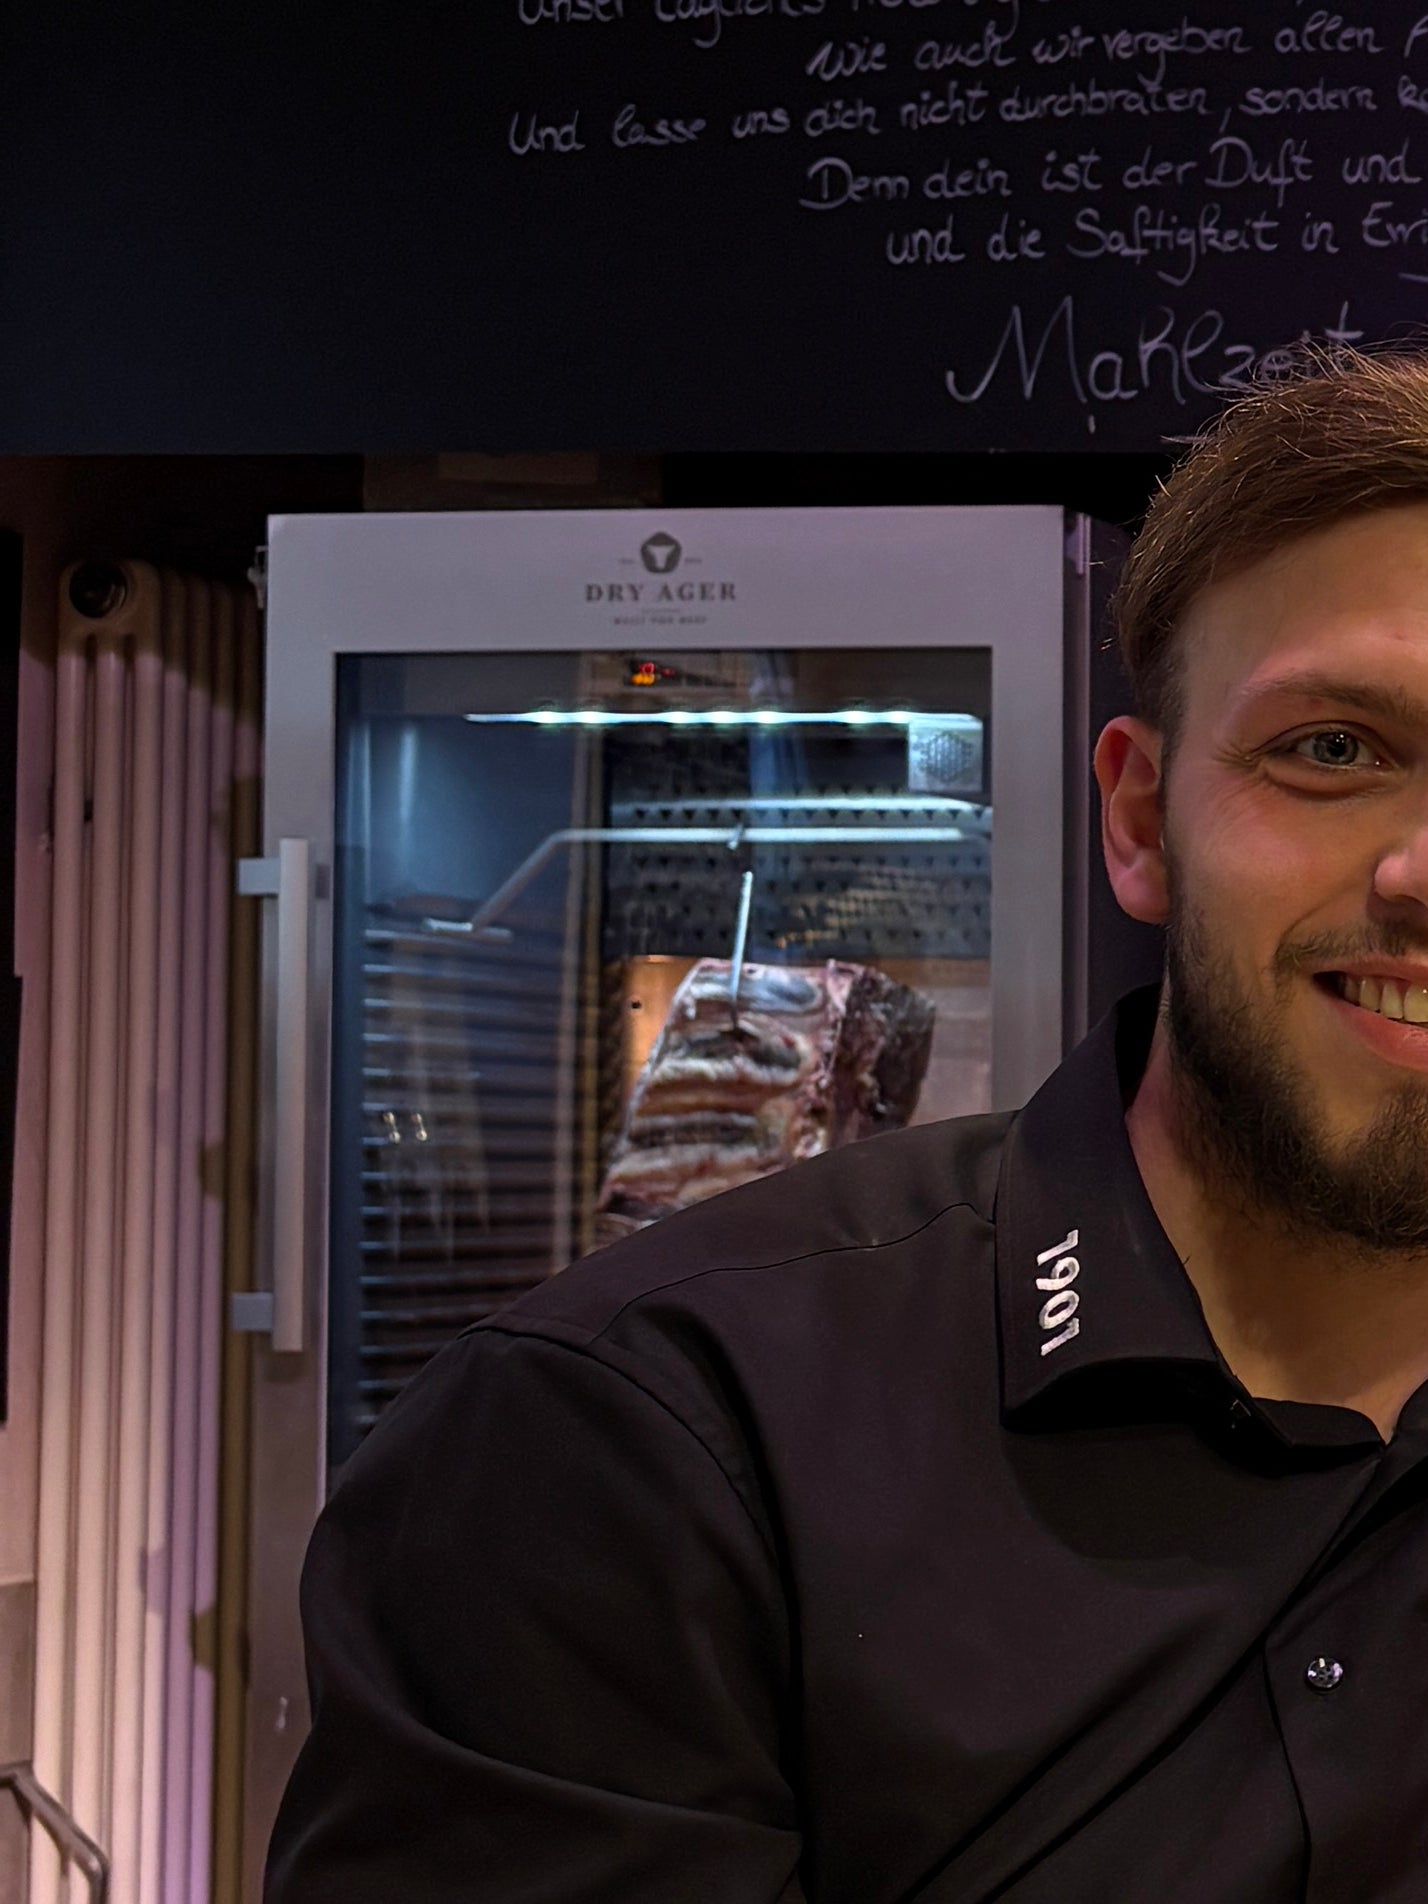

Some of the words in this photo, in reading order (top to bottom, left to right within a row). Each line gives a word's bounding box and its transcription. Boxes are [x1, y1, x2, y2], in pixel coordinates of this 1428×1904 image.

[913, 20, 1016, 72] auch
[1031, 25, 1092, 64] wir
[1101, 14, 1254, 87] vergeben
[1273, 9, 1387, 55] allen
[506, 110, 586, 157] Und
[610, 102, 708, 149] lasse
[731, 104, 792, 139] uns
[803, 89, 883, 137] dich
[900, 80, 990, 131] nicht
[799, 156, 911, 211] Denn
[922, 156, 1013, 201] dein
[1041, 148, 1104, 194] ist
[1121, 144, 1200, 190] der
[1204, 135, 1315, 209] Duft
[1341, 139, 1423, 184] und
[885, 213, 968, 267] und
[985, 212, 1048, 263] die
[1065, 201, 1281, 287] Saftigkeit
[1301, 211, 1341, 255] in
[585, 582, 644, 602] DRY
[658, 581, 737, 602] AGER
[1035, 1228, 1081, 1357] 1901
